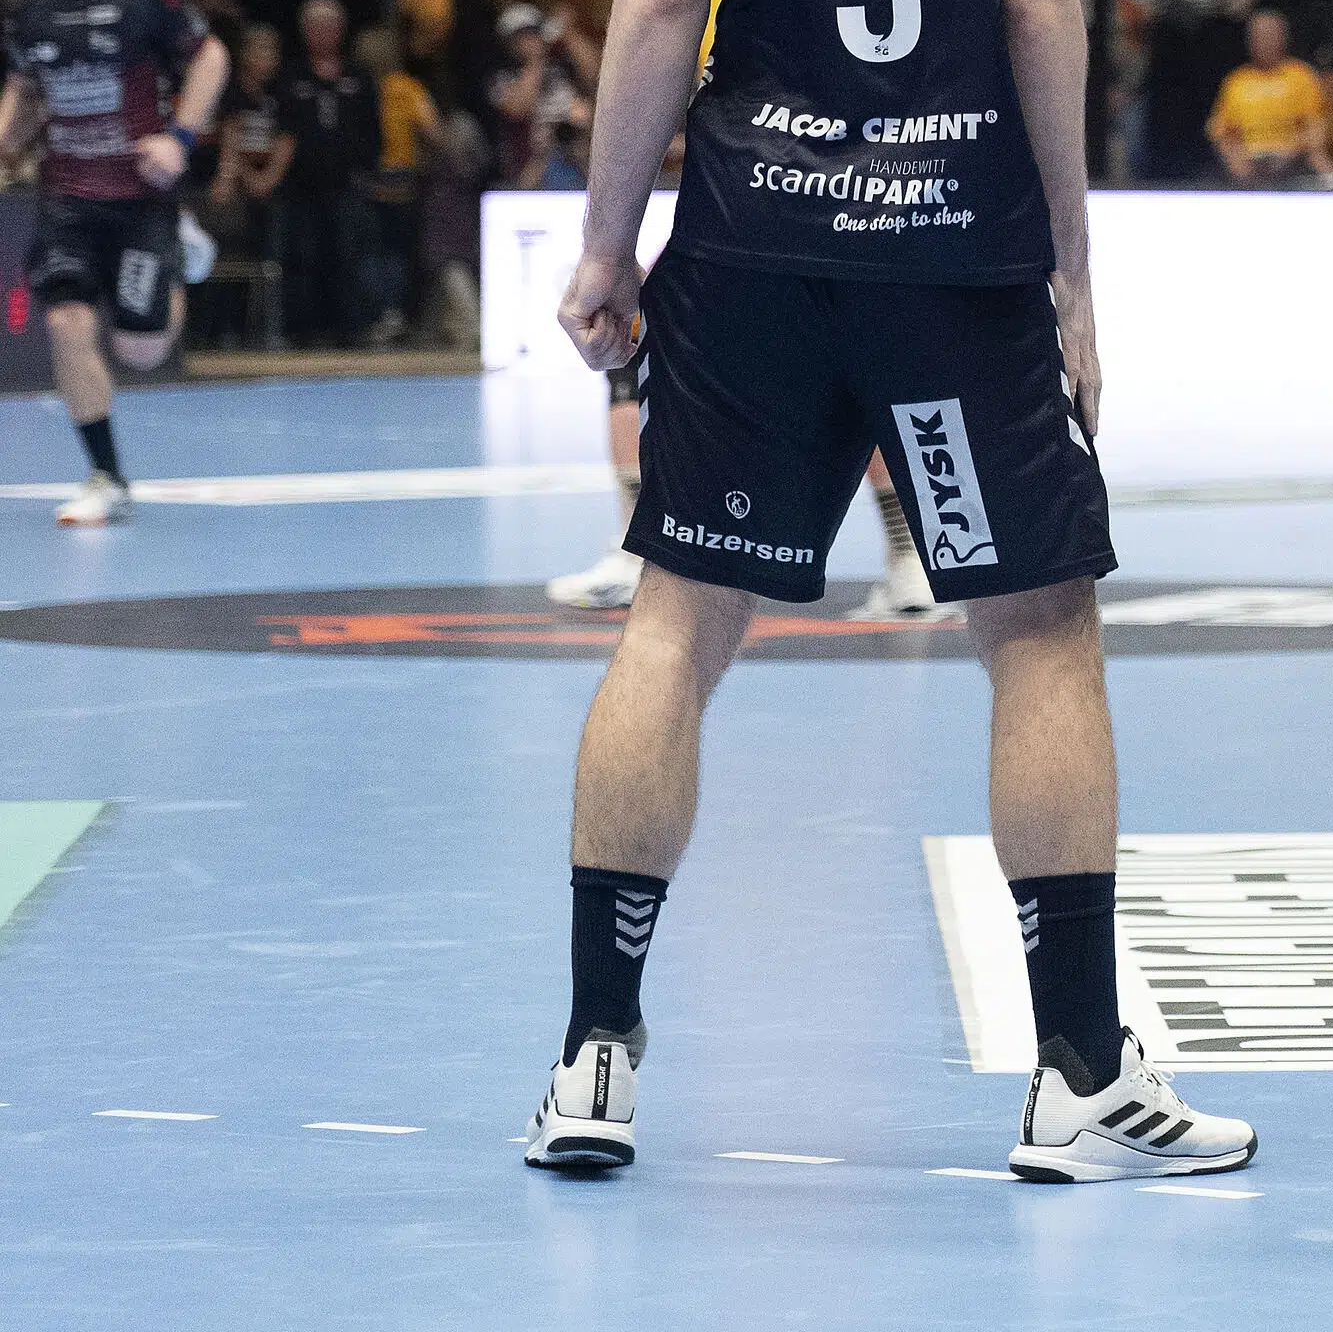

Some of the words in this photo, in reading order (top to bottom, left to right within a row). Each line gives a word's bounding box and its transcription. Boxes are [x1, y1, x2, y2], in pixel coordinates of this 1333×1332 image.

[751, 103, 848, 141] JACOB
[869, 159, 947, 175] HANDEWITT
[833, 212, 869, 233] One
[869, 213, 908, 234] stop
[911, 210, 931, 227] to
[933, 206, 975, 229] shop
[909, 409, 970, 534] JYSK
[661, 513, 814, 564] Balzersen
